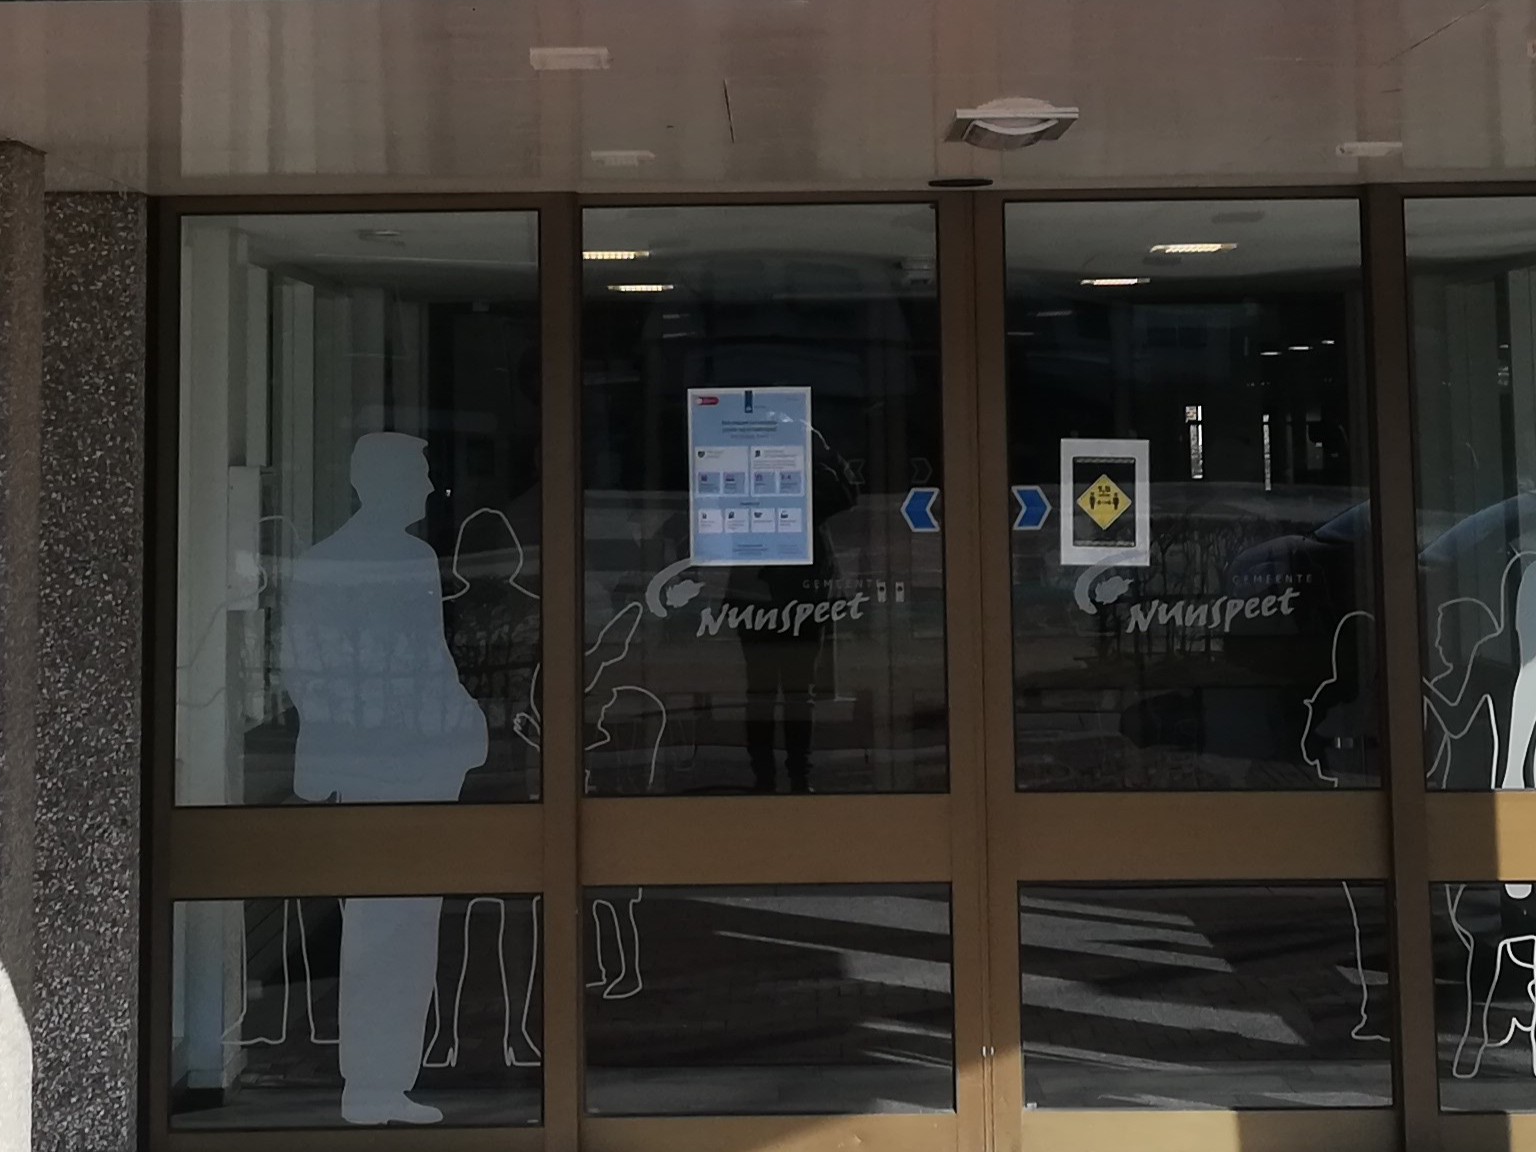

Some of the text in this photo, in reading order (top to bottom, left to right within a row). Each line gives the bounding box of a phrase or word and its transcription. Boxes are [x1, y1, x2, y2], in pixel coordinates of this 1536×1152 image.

[1231, 573, 1313, 585] GEMEENTE
[696, 592, 870, 638] Nunspeet
[1125, 587, 1301, 633] Nunspeet
